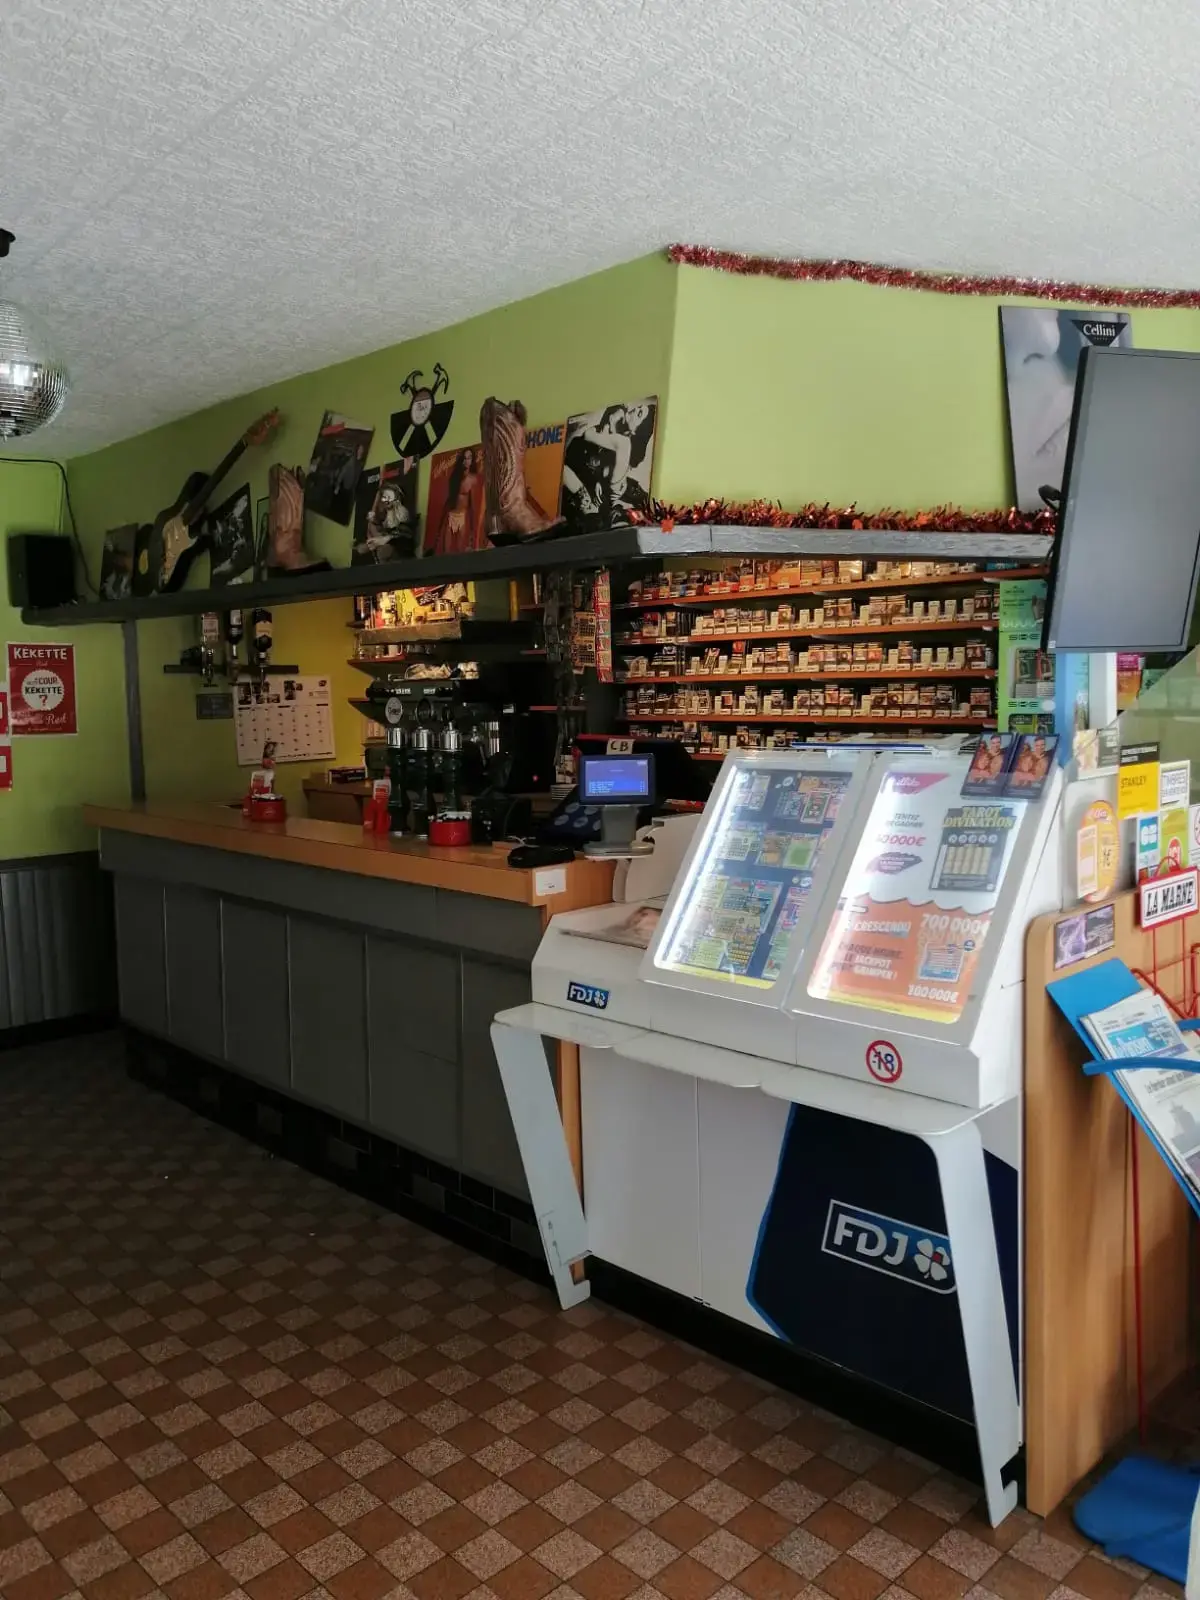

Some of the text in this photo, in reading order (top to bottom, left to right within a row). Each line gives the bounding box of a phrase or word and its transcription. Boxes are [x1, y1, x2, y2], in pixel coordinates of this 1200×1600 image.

[1083, 323, 1117, 338] Cellini
[610, 740, 629, 752] CB
[961, 806, 1003, 819] TAROT
[942, 817, 1014, 829] DIVINATION
[569, 984, 593, 1003] FDJ
[833, 1213, 909, 1265] FDJ
